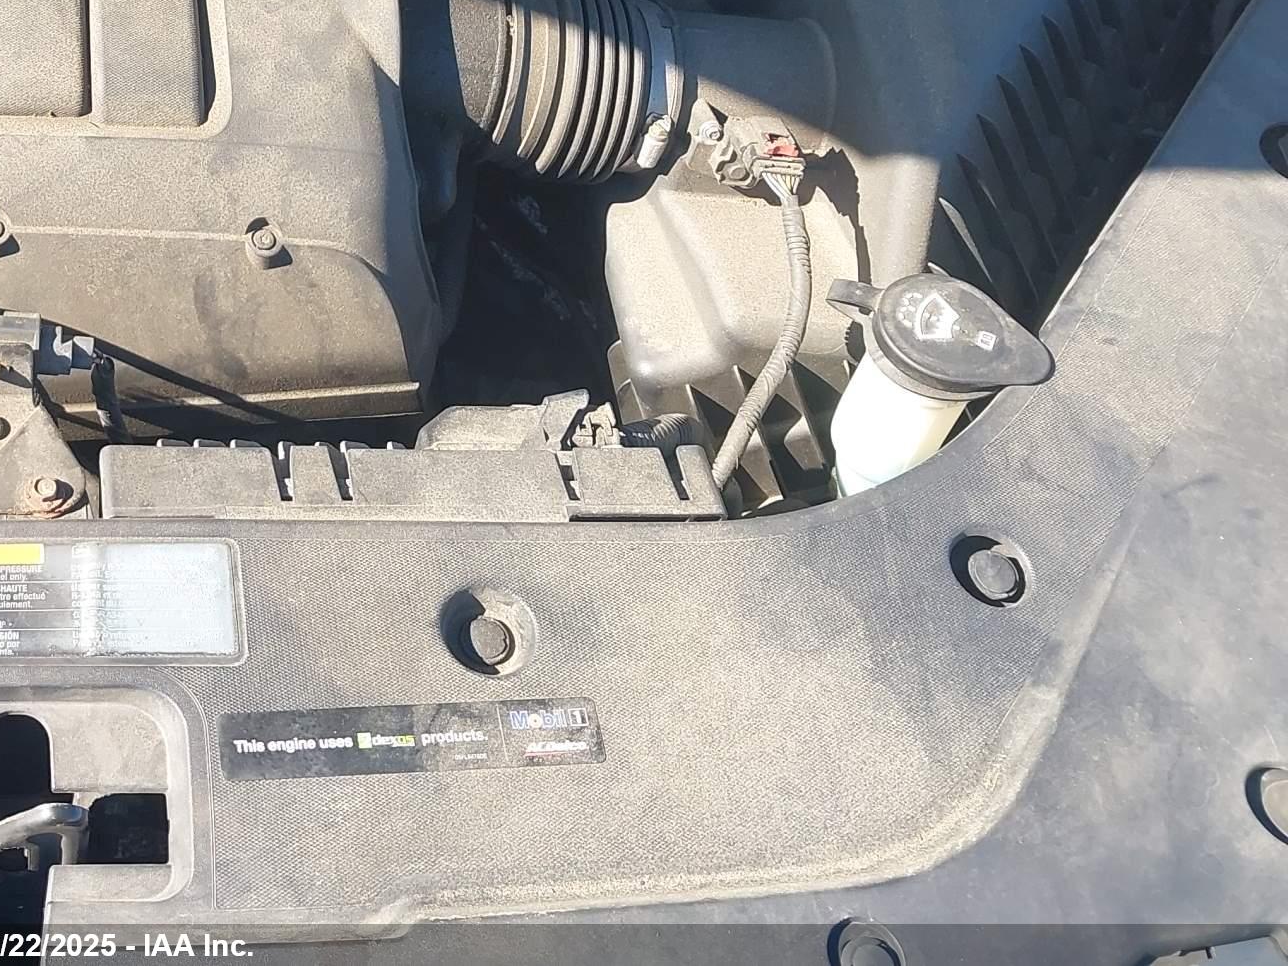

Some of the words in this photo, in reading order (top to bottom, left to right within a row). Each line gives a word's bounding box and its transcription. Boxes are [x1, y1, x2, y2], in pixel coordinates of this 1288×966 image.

[0, 584, 28, 593] HAUTE
[7, 641, 21, 649] por
[510, 709, 567, 730] Mobil
[233, 739, 265, 754] This
[267, 737, 317, 753] engine
[319, 737, 353, 749] uses
[421, 730, 489, 746] products.
